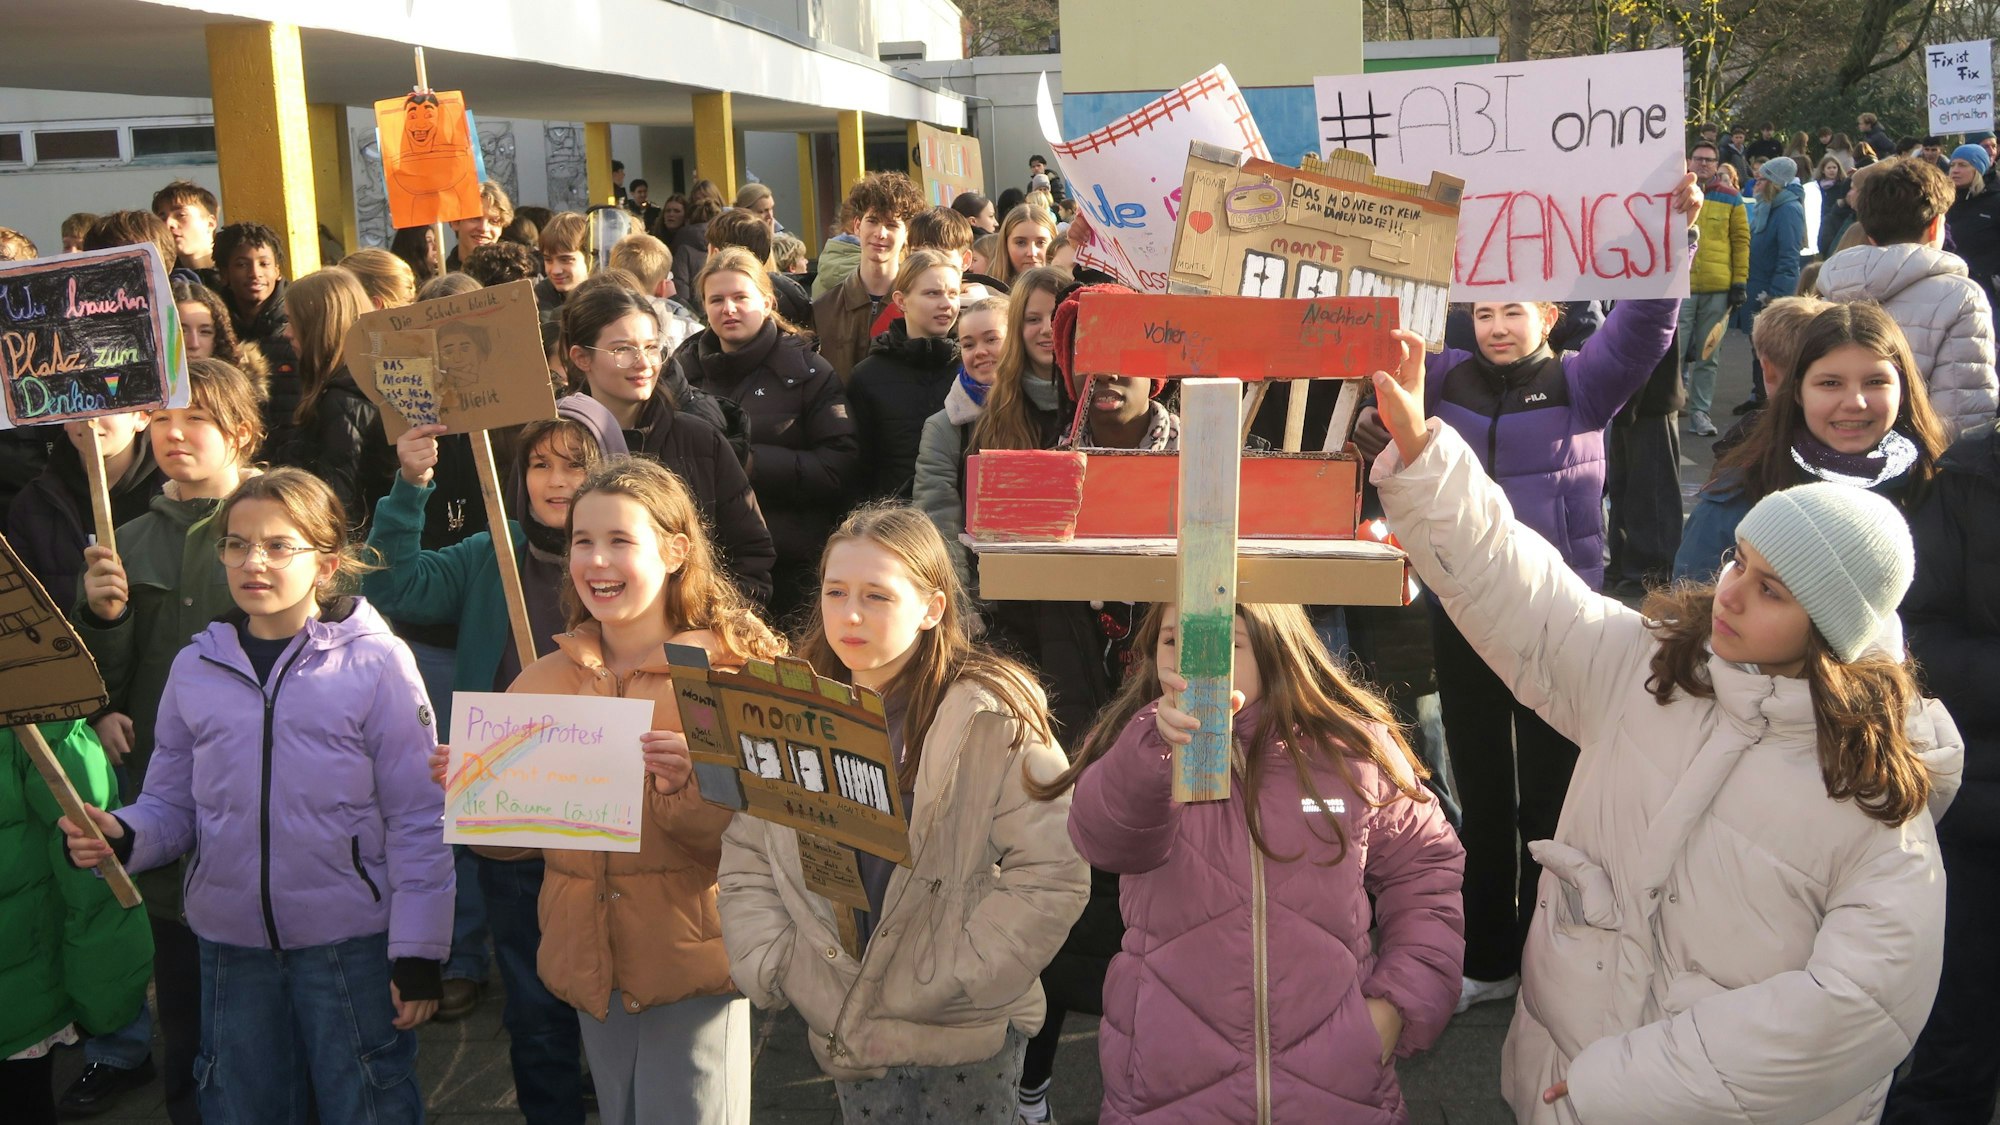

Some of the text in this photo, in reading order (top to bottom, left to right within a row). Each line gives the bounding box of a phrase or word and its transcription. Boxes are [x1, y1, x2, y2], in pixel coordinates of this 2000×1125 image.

[1928, 50, 1970, 68] Fix ist
[1957, 67, 1980, 80] Fix
[1552, 78, 1666, 152] ohne
[1292, 182, 1320, 202] DAS
[1327, 193, 1377, 213] MONTE
[1380, 204, 1395, 217] IST
[0, 276, 148, 321] Wir brauchen
[389, 315, 412, 332] Die
[424, 301, 462, 322] Schule
[3, 331, 139, 380] Platz zum
[1524, 392, 1547, 403] FILA
[467, 706, 535, 743] Protest
[538, 714, 603, 745] Protest
[462, 790, 487, 816] die
